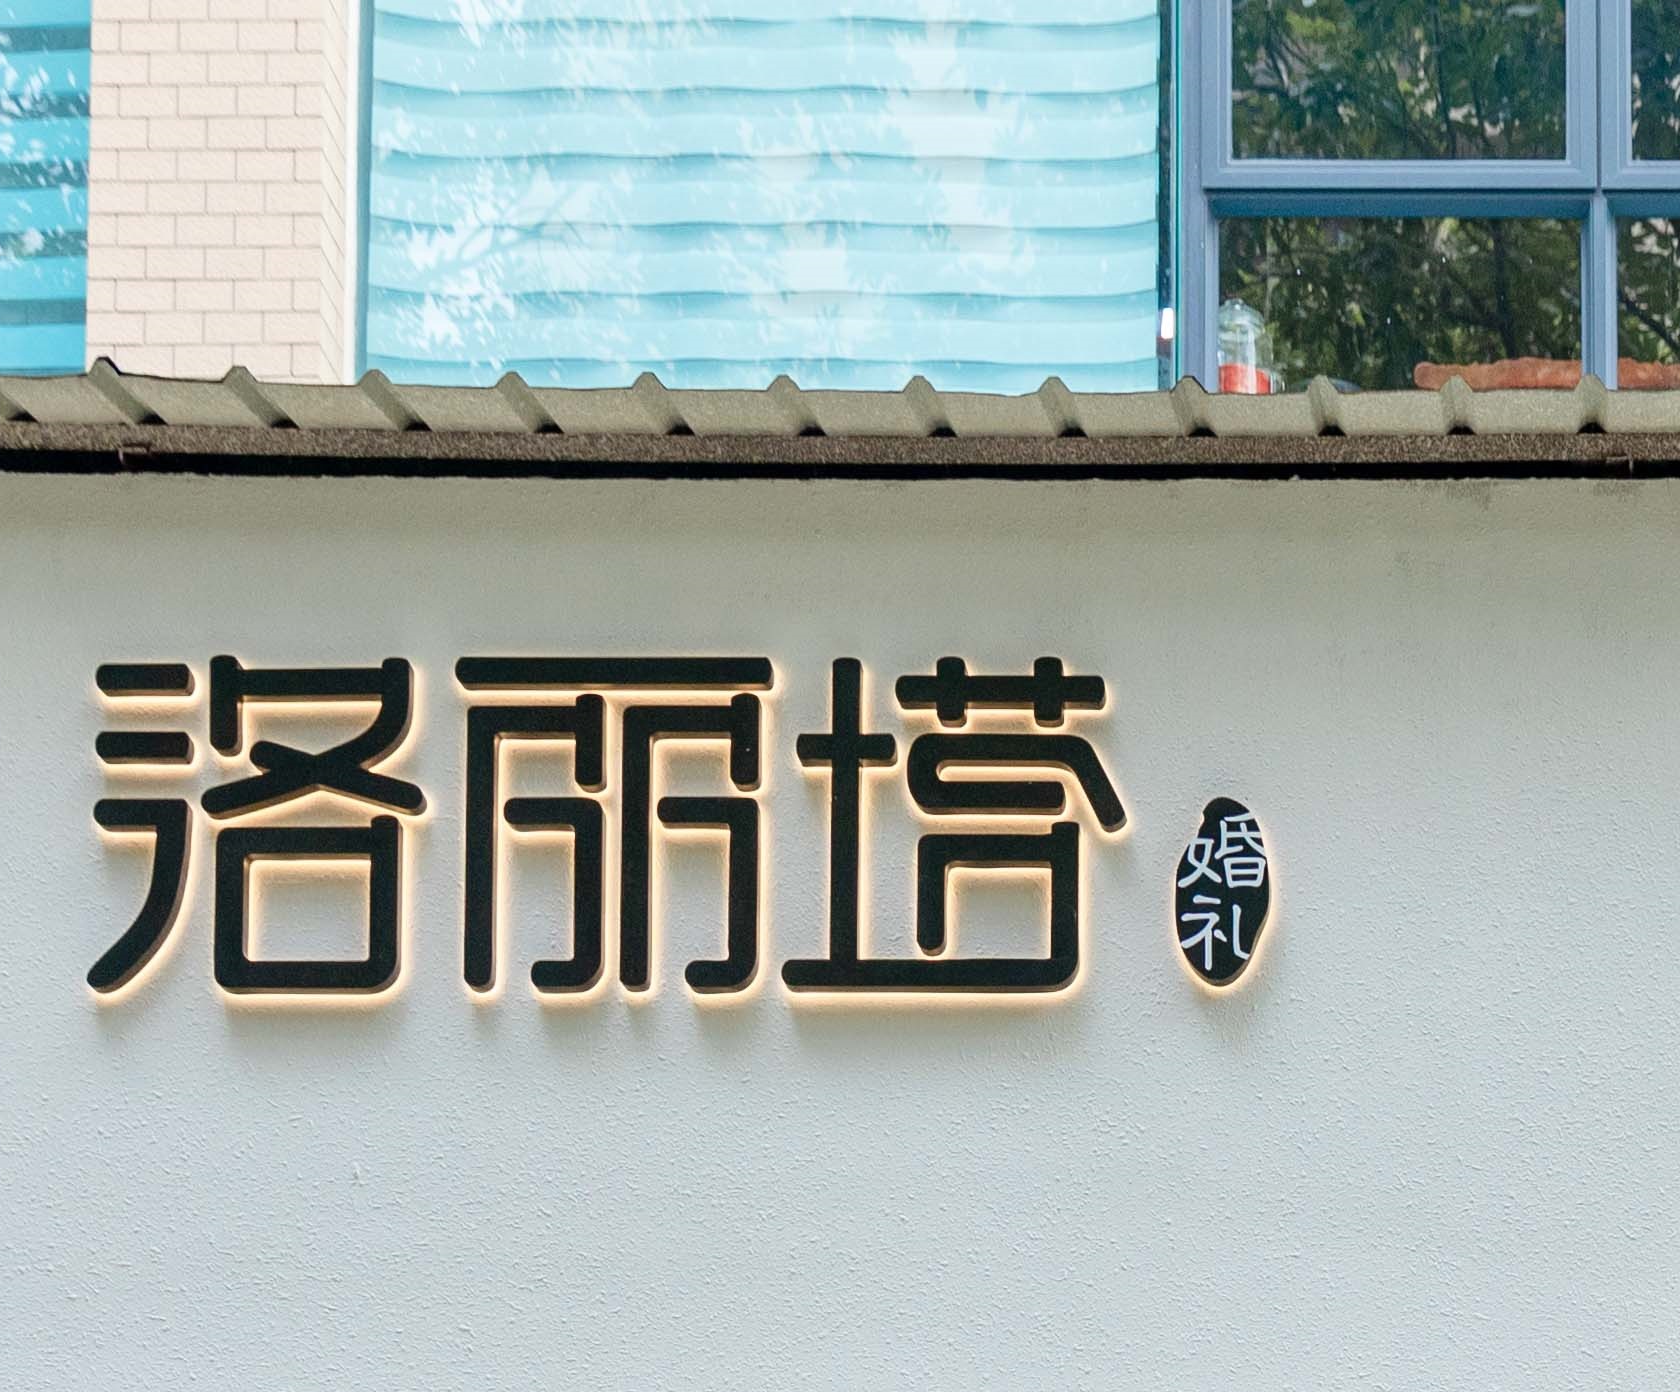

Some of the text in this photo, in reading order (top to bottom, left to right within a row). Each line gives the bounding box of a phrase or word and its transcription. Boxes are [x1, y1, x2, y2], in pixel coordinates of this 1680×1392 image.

[86, 655, 1128, 994] 洛丽塔
[1176, 812, 1270, 972] 婚礼
